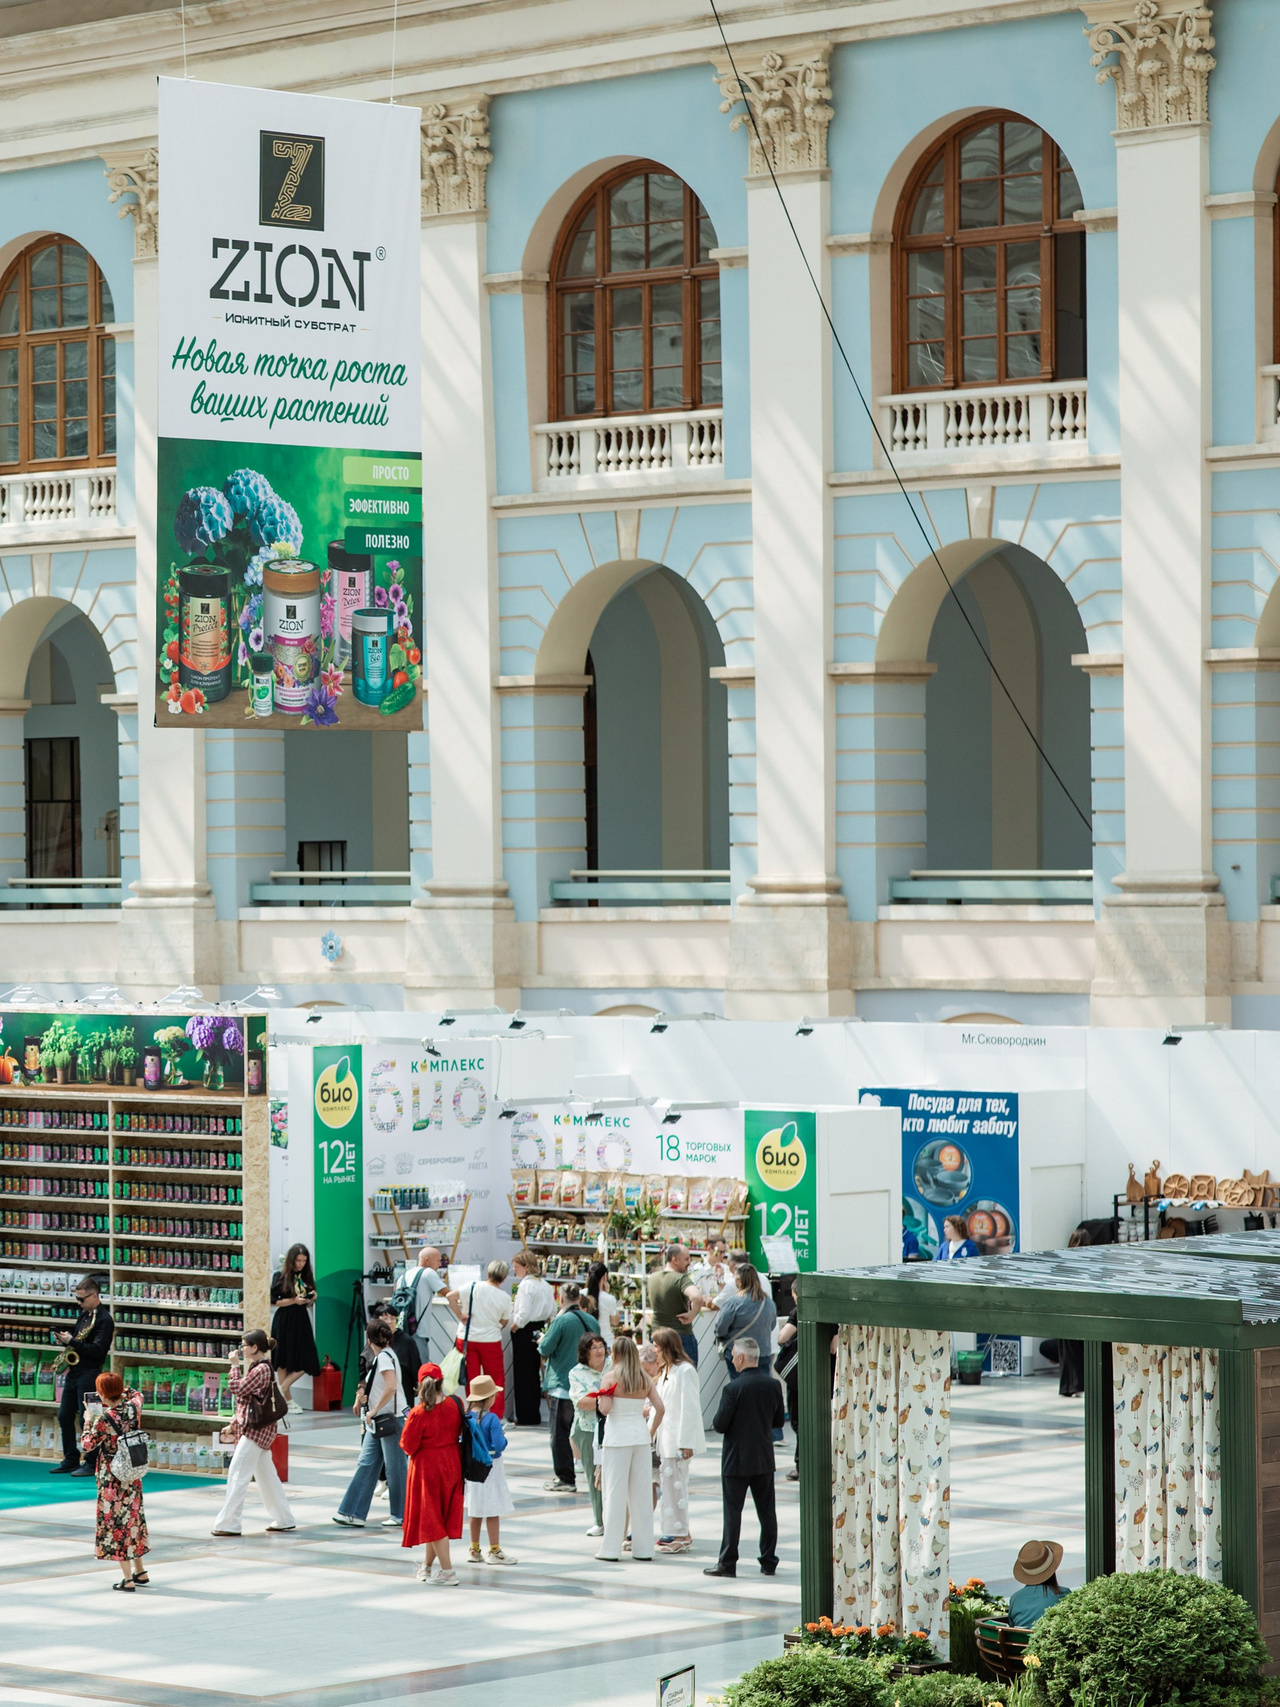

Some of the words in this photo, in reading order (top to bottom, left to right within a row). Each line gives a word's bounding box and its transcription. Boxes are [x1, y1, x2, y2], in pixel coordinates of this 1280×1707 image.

[172, 336, 249, 375] Новая
[254, 352, 328, 381] точка
[330, 358, 408, 391] роста
[190, 380, 268, 423] ваших
[270, 394, 390, 430] растений
[372, 464, 410, 481] ПРОСТО
[349, 498, 410, 515] ЭФФЕКТИВНО
[365, 534, 410, 550] ПОЛЕЗНО
[342, 588, 361, 596] ZION
[192, 621, 219, 633] Protect
[194, 615, 217, 624] ZION
[279, 619, 305, 631] ZION
[961, 1033, 1046, 1048] Mr.Сковородкин
[320, 1082, 353, 1103] био
[908, 1093, 955, 1114] Посуда
[956, 1097, 982, 1115] для
[986, 1098, 1011, 1116] тех,
[902, 1117, 925, 1132] кто
[927, 1114, 970, 1134] любит
[972, 1116, 1017, 1138] заботу
[655, 1134, 681, 1161] 18
[685, 1141, 732, 1152] ТОРГОВЫХ
[318, 1139, 345, 1174] 12
[345, 1141, 356, 1173] ЛЕТ
[685, 1154, 717, 1163] МАРОК
[762, 1145, 800, 1167] био
[323, 1176, 333, 1184] НА
[333, 1175, 355, 1183] РЫНКЕ
[754, 1202, 792, 1237] 12
[795, 1205, 809, 1245] ЛЕТ
